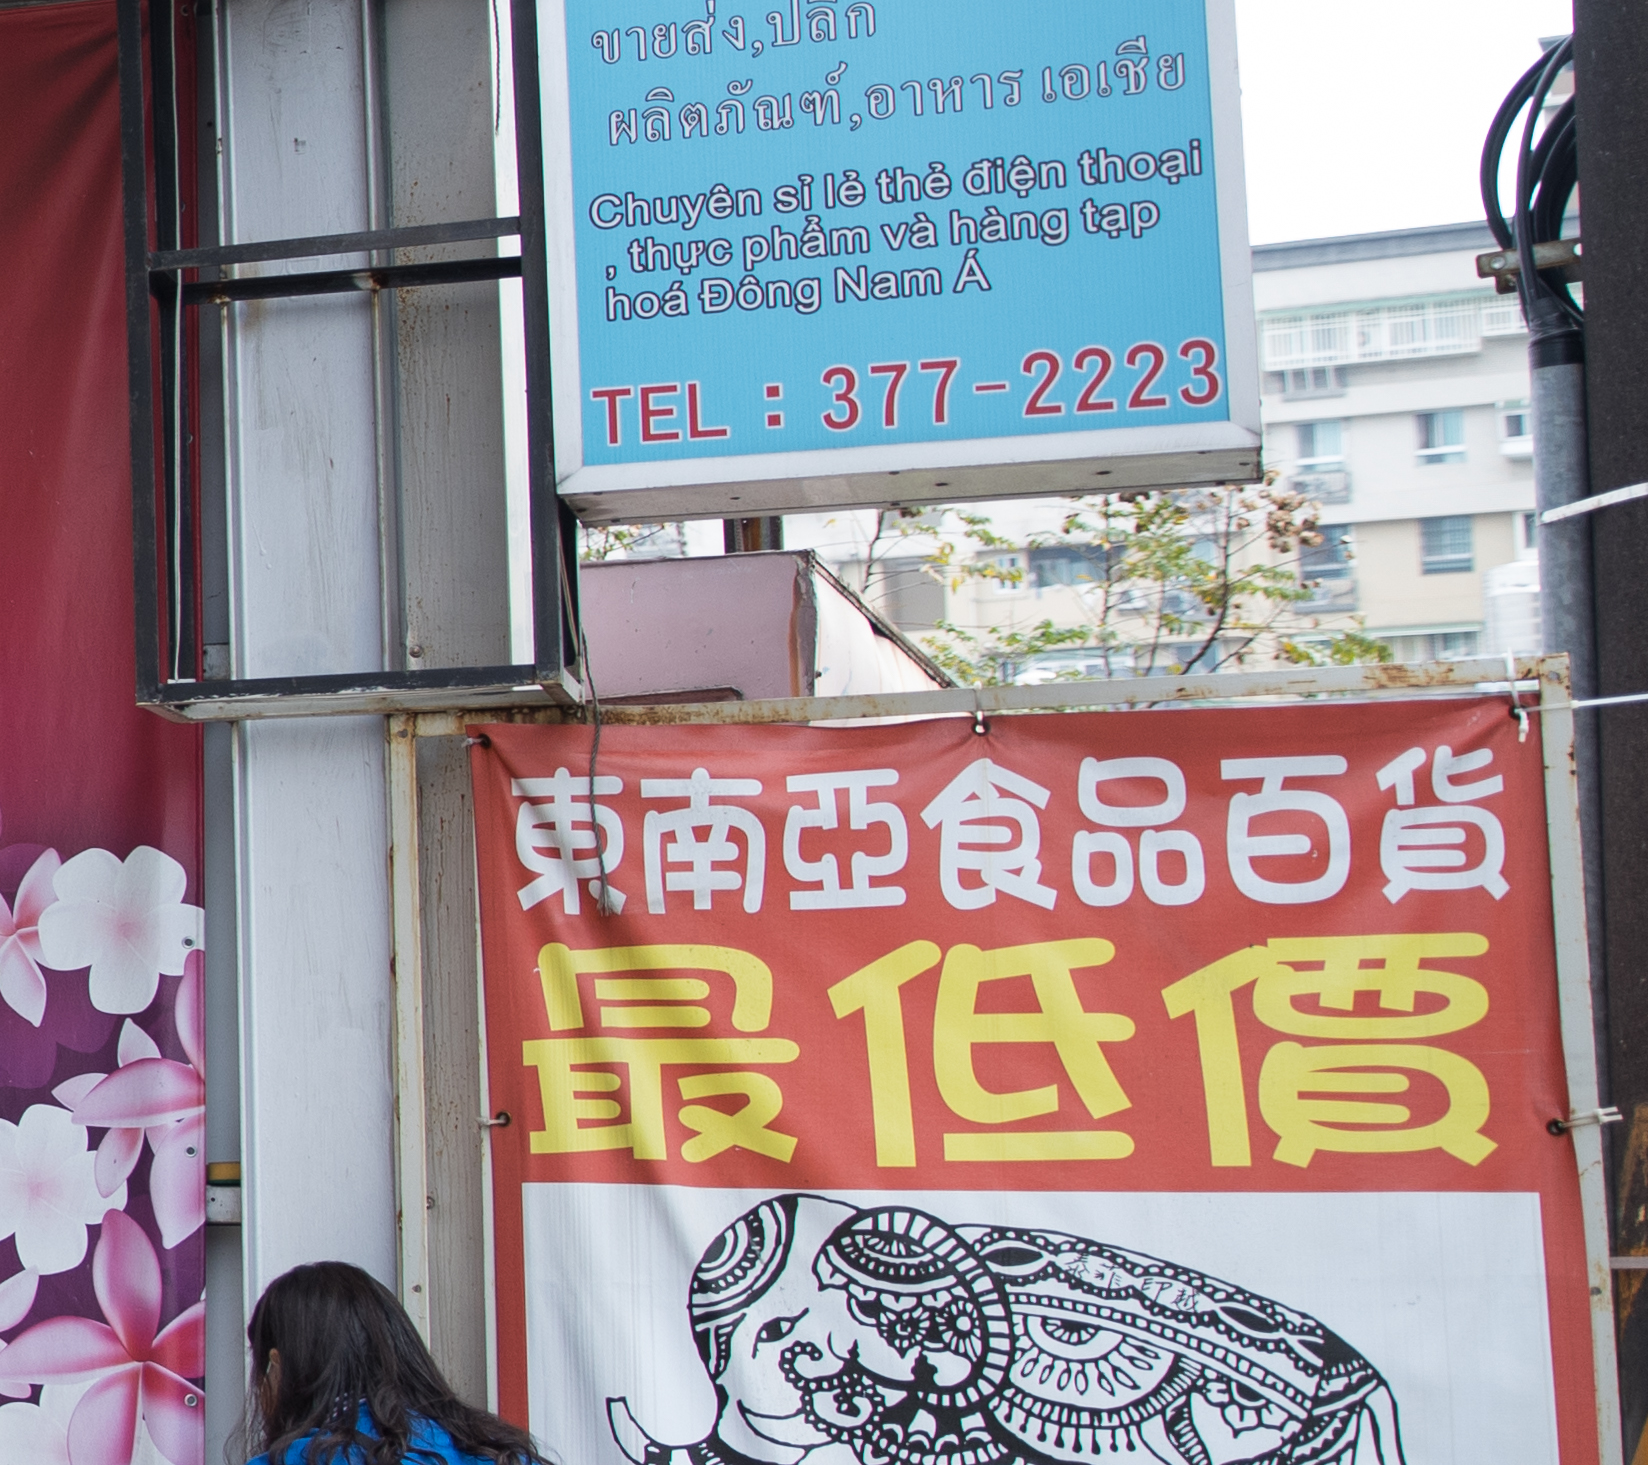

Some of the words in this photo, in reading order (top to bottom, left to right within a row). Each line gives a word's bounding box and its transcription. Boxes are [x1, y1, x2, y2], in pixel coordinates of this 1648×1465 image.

[1041, 35, 1187, 104] เอเชีย
[589, 180, 763, 233] Chuyên
[773, 173, 815, 216] sỉ
[824, 163, 866, 208] lẻ
[876, 160, 952, 205] thẻ
[963, 152, 1067, 200] điện
[1078, 137, 1203, 187] thoại
[605, 281, 689, 323] hoá
[698, 273, 823, 319] Đông
[834, 259, 944, 304] Nam
[952, 246, 993, 295] Á
[628, 232, 733, 279] thực
[743, 214, 870, 273] phẩm
[882, 209, 939, 252] và
[949, 199, 1070, 251] hàng
[1082, 195, 1161, 244] tạp
[820, 337, 1224, 434] 377-2223
[512, 746, 1512, 916] 東南亞食品百貨
[522, 932, 1500, 1170] 最低價
